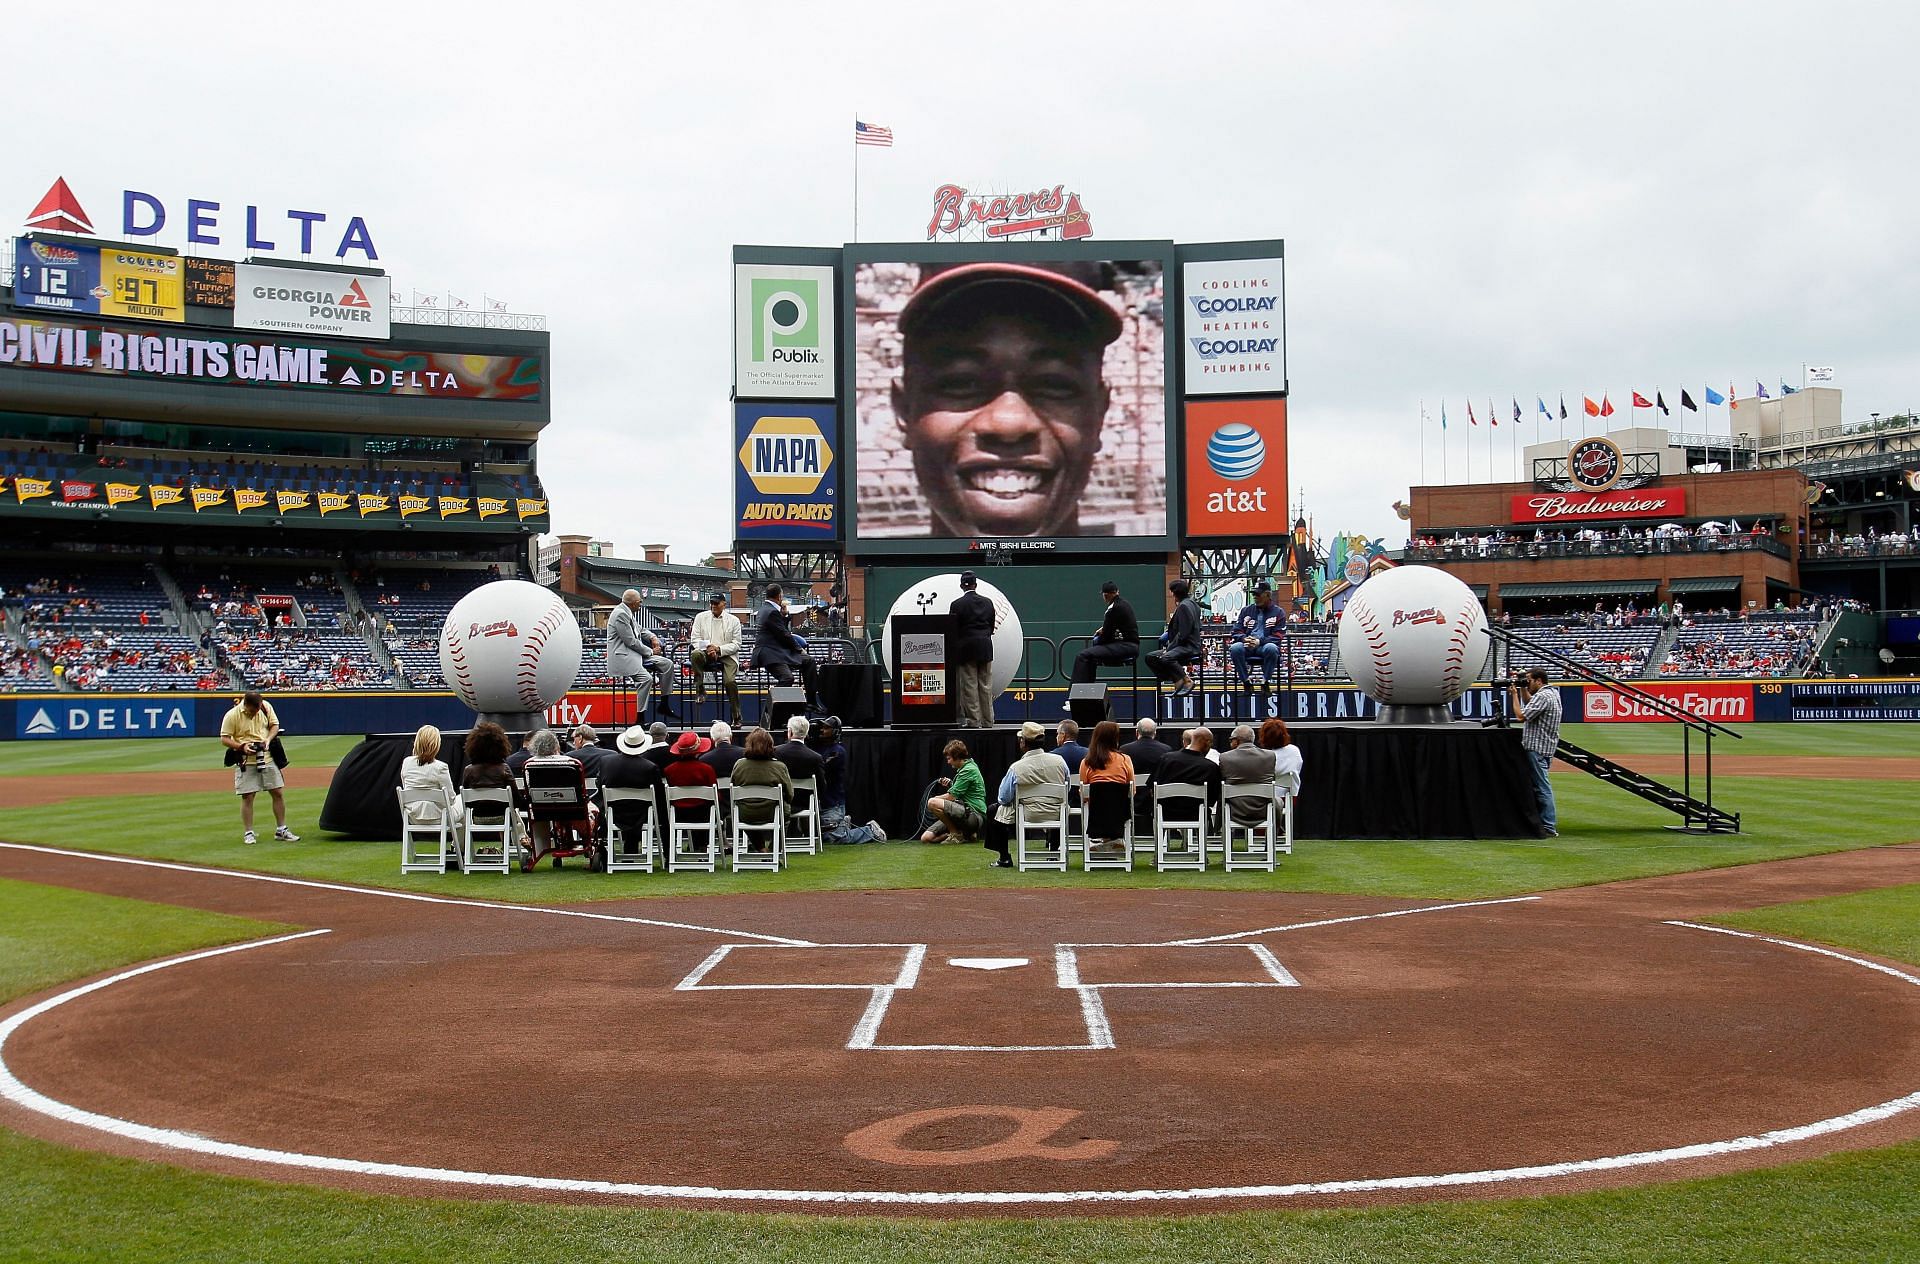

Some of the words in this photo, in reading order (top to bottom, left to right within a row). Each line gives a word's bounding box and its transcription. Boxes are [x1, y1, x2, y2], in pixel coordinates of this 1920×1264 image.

[927, 183, 1065, 241] Braves
[123, 189, 379, 261] DELTA
[187, 259, 234, 273] Welcome
[41, 267, 67, 295] 12
[193, 281, 229, 293] Turner
[1202, 279, 1269, 290] COOLING
[34, 295, 73, 308] MILLION
[196, 293, 225, 305] Field
[252, 286, 335, 305] GEORGIA
[1197, 296, 1279, 313] COOLRAY
[127, 305, 164, 317] MILLION
[309, 305, 372, 322] POWER
[259, 319, 303, 329] SOUTHERN
[305, 323, 344, 332] COMPANY
[1203, 320, 1270, 332] HEATING
[1198, 338, 1279, 355] COOLRAY
[0, 322, 93, 368] CIVIL
[101, 331, 229, 378] RIGHTS
[234, 344, 329, 384] GAME
[772, 348, 819, 363] Publix
[1203, 362, 1271, 374] PLUMBING
[370, 368, 459, 389] DELTA
[755, 437, 819, 474] NAPA
[19, 483, 45, 494] 1993
[110, 487, 133, 498] 1996
[153, 489, 177, 501] 1997
[195, 493, 219, 503] 1998
[237, 494, 261, 504] 1999
[278, 495, 303, 505] 2000
[1206, 486, 1267, 513] at&t
[320, 497, 344, 507] 2001
[360, 499, 383, 509] 2002
[401, 499, 424, 510] 2003
[440, 501, 464, 511] 2004
[479, 502, 503, 511] 2005
[519, 503, 540, 512] 2010
[1528, 496, 1667, 518] Budweiser
[742, 503, 786, 520] AUTO
[786, 503, 834, 520] PARTS
[980, 542, 1019, 550] MITSBISHI
[1021, 541, 1056, 549] ELECTRIC
[1392, 606, 1436, 629] Braves
[468, 620, 509, 641] Braves
[1759, 684, 1782, 694] 390
[1797, 685, 1810, 694] THE
[1814, 685, 1846, 694] LONGEST
[1850, 684, 1906, 694] CONTINUOUSLY
[1013, 692, 1034, 701] 400
[1165, 693, 1231, 719] THIS
[1251, 693, 1278, 719] IS
[69, 708, 188, 731] DELTA
[1796, 710, 1839, 719] FRANCHISE
[1843, 710, 1851, 718] IN
[1855, 709, 1880, 718] MAJOR
[1884, 709, 1913, 718] LEAGUE
